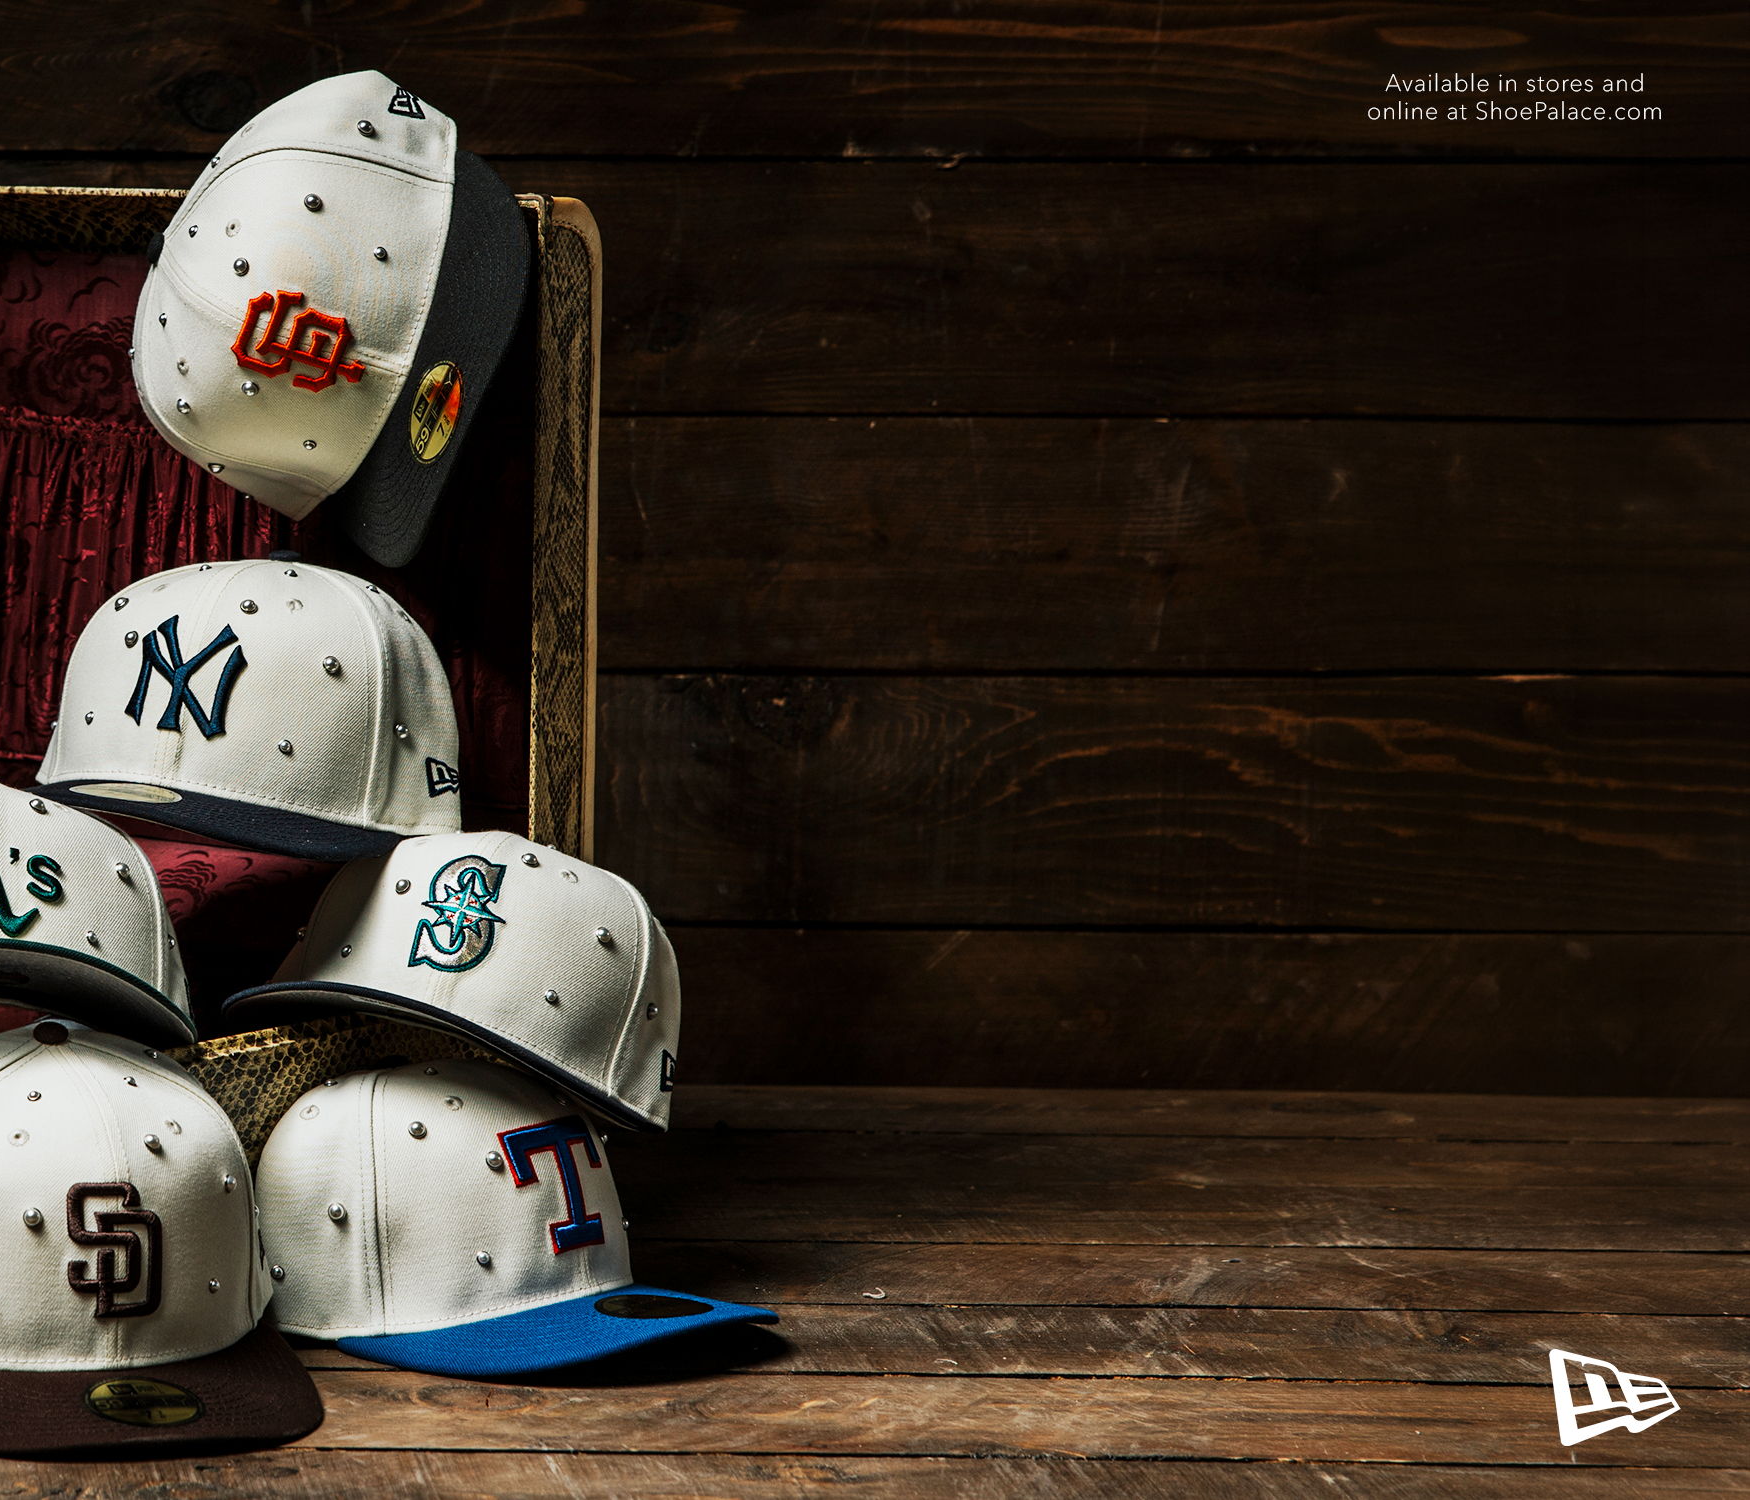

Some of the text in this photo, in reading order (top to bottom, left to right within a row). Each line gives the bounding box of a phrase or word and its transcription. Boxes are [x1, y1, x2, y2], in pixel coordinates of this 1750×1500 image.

[231, 290, 366, 394] SF
[124, 614, 248, 740] NY
[407, 854, 507, 972] S
[496, 1115, 605, 1255] T
[66, 1181, 162, 1319] SD
